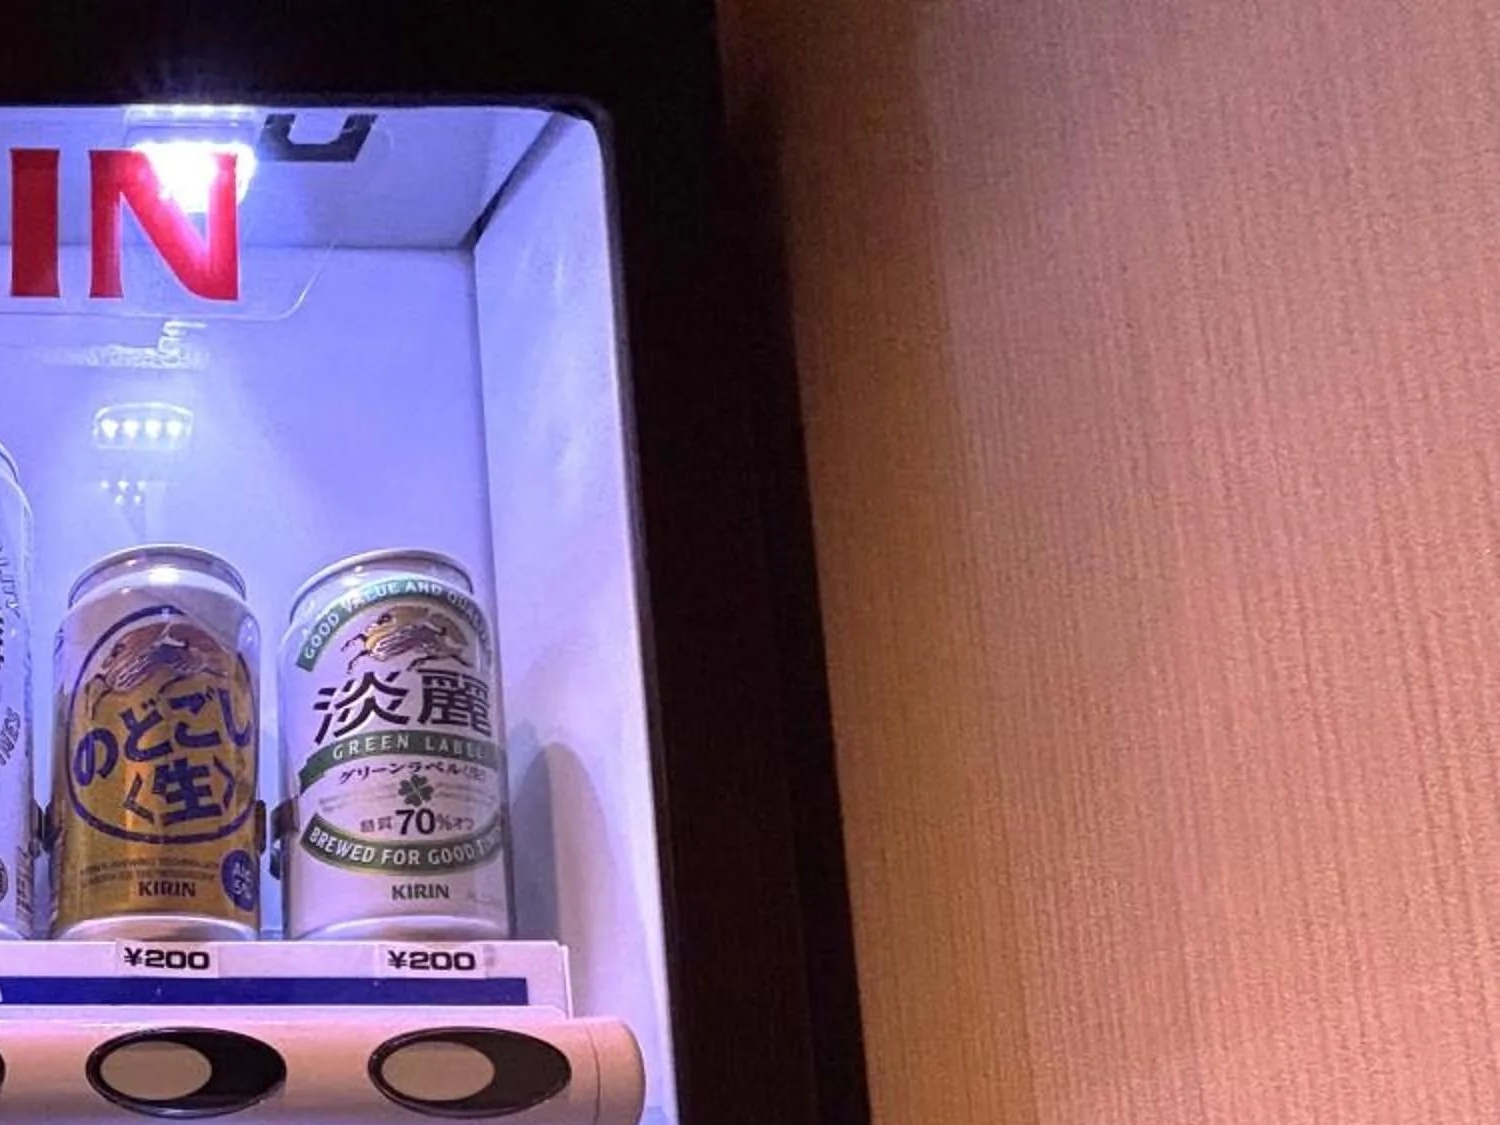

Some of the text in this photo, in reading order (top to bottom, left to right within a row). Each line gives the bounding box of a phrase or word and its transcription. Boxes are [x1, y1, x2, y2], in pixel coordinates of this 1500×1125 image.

[303, 612, 340, 660] GOOD
[405, 581, 444, 597] AND
[313, 669, 492, 745] 淡麗
[332, 734, 410, 761] GREEN
[309, 826, 475, 866] BREWED FOR GOOD
[138, 880, 197, 898] KIRIN
[391, 883, 450, 901] KIRIN
[124, 946, 210, 970] ¥200
[388, 949, 476, 971] ¥200
